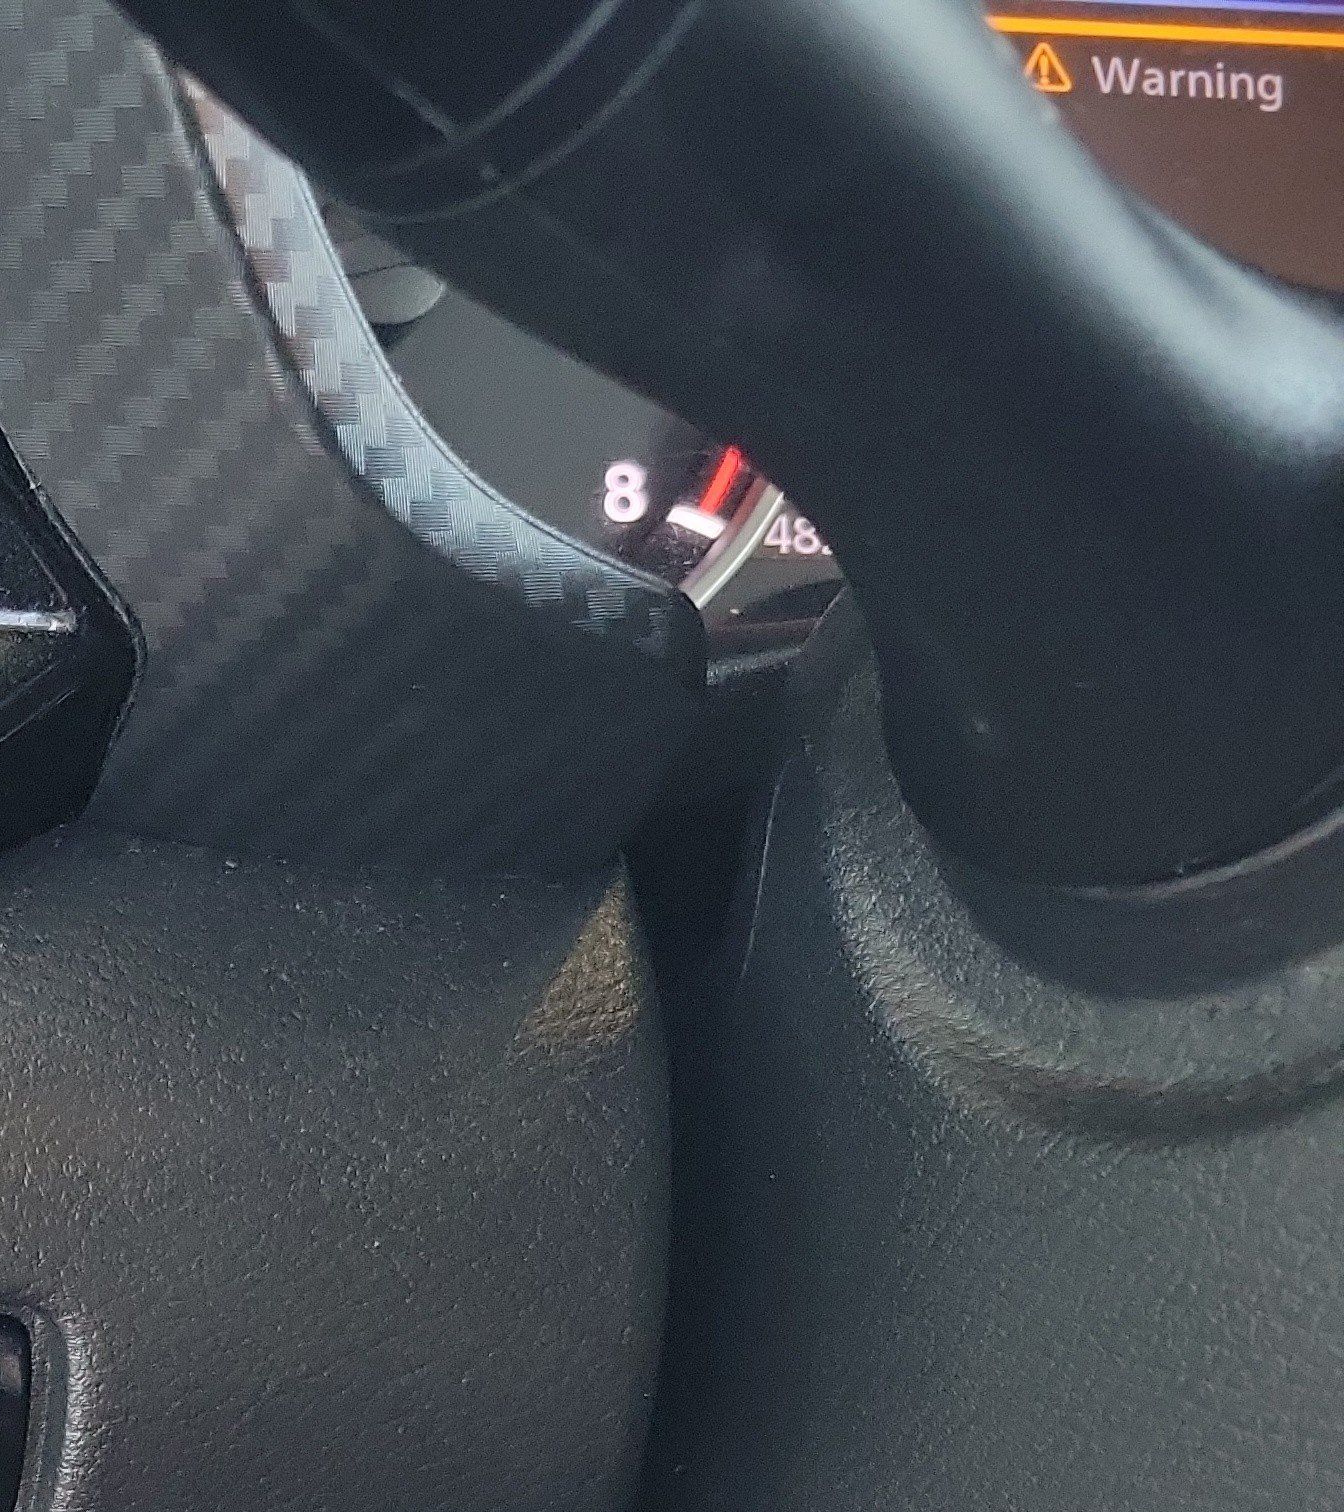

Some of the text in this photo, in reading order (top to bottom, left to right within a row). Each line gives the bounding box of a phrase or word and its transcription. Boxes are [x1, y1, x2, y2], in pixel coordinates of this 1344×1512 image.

[1091, 55, 1284, 112] Warning
[602, 460, 649, 524] 8
[762, 513, 833, 556] 48
